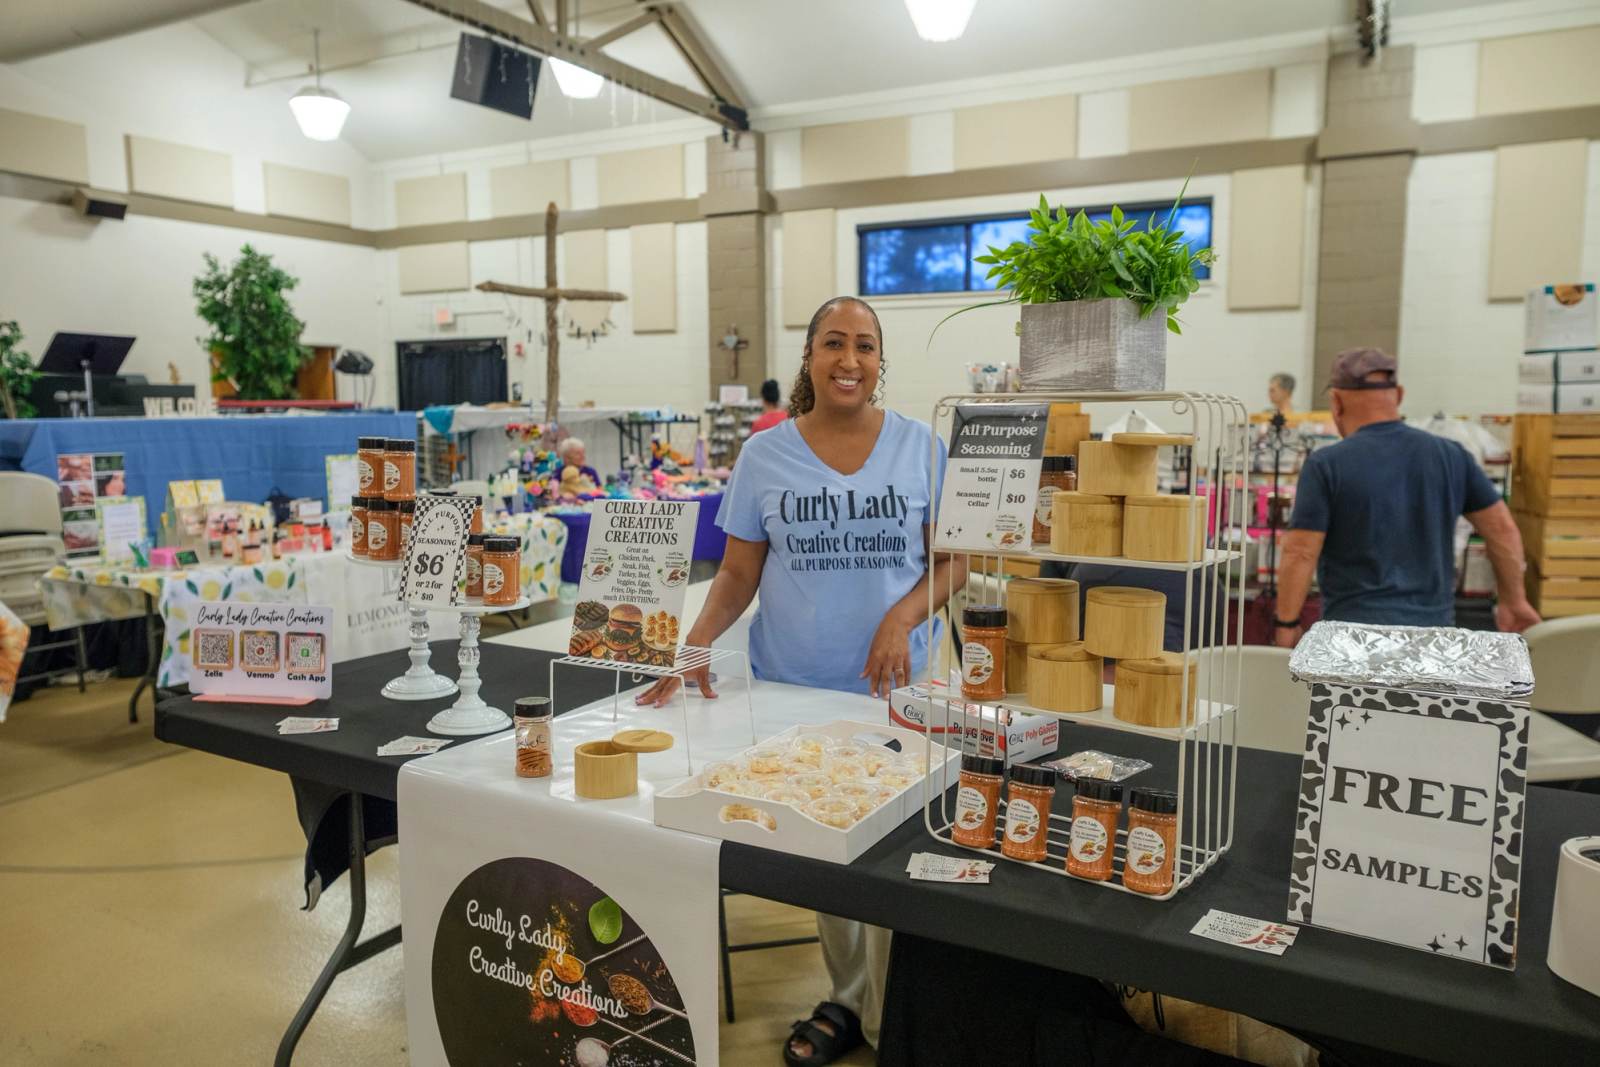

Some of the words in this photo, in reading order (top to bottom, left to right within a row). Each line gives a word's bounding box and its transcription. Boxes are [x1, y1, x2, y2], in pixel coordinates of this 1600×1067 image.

[960, 424, 979, 436] All
[982, 425, 1038, 438] Purpose
[961, 442, 1031, 457] Seasoning
[1010, 469, 1025, 479] $6
[956, 491, 990, 500] Seasoning
[1006, 494, 1026, 504] $10
[605, 501, 647, 514] CURLY
[650, 502, 685, 516] LADY
[780, 487, 841, 530] Curly
[846, 485, 909, 527] Lady
[420, 518, 434, 535] ALL
[436, 510, 460, 536] PURPOSE
[610, 516, 674, 530] CREATIVE
[417, 537, 457, 546] SEASONING
[605, 530, 678, 545] CREATIONS
[786, 530, 840, 554] Creative
[844, 529, 906, 553] Creations
[414, 551, 444, 578] $6
[806, 557, 852, 572] PURPOSE
[854, 556, 904, 570] SEASONING
[431, 581, 443, 589] for
[421, 592, 434, 601] $10
[198, 606, 224, 625] Curly
[226, 606, 248, 626] Lady
[250, 607, 284, 626] Creative
[286, 608, 324, 627] Creations
[204, 670, 224, 678] Zelle
[246, 671, 275, 679] Venmo
[308, 674, 326, 682] App
[953, 722, 969, 738] Poy
[1328, 766, 1488, 826] FREE
[1322, 848, 1484, 898] SAMPLES
[466, 900, 515, 950] Curly
[518, 915, 567, 965] Lady
[469, 946, 536, 990] Creative
[540, 969, 629, 1018] Creations
